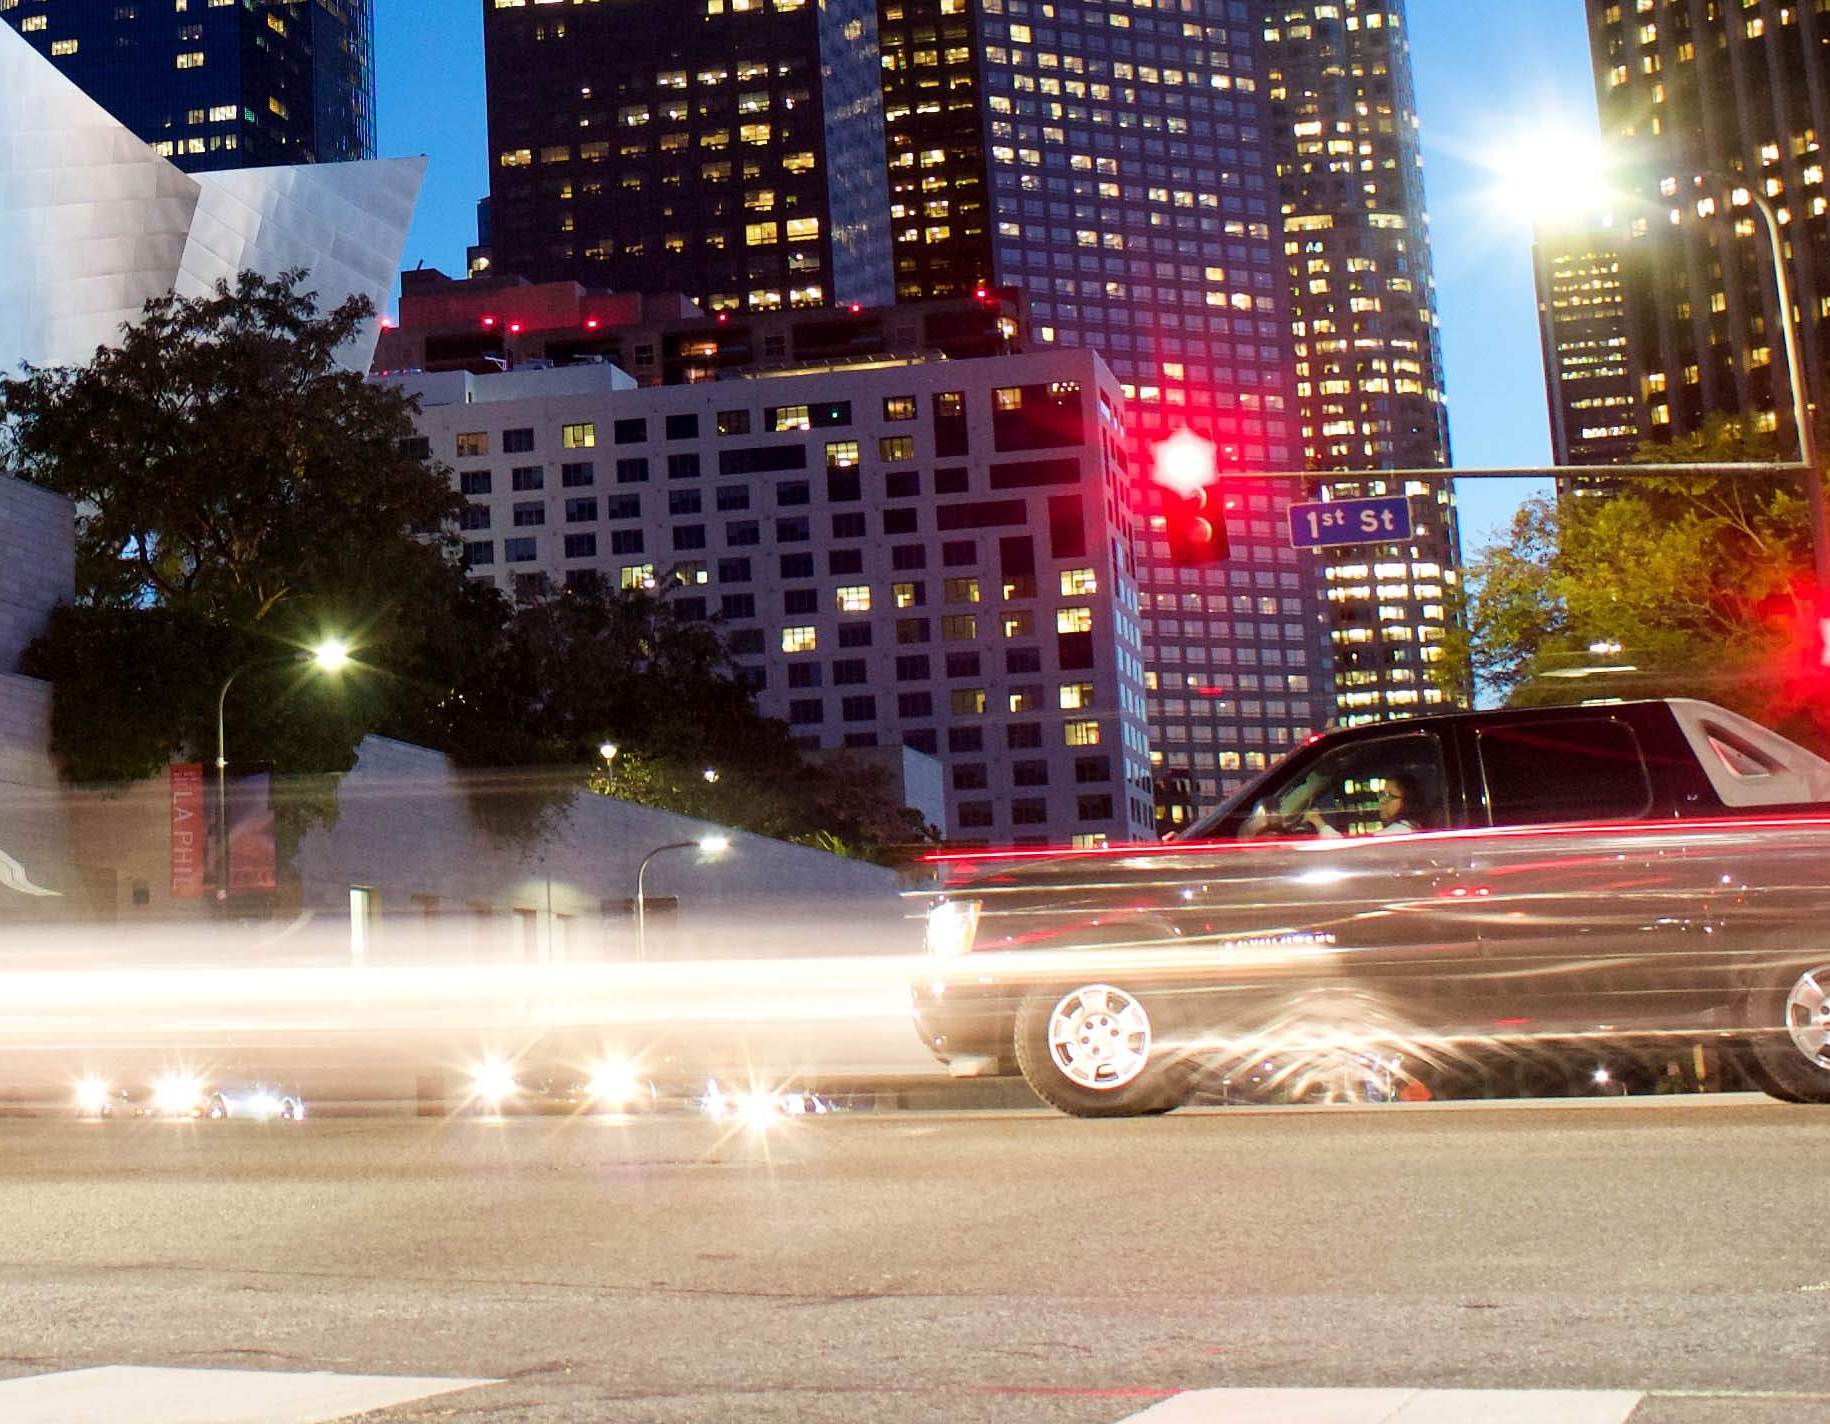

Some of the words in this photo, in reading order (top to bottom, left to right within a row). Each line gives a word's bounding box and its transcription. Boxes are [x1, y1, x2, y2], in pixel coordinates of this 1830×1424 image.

[1307, 508, 1345, 538] 1st
[1360, 509, 1394, 533] St
[173, 791, 194, 822] LA
[173, 832, 194, 889] PHIL
